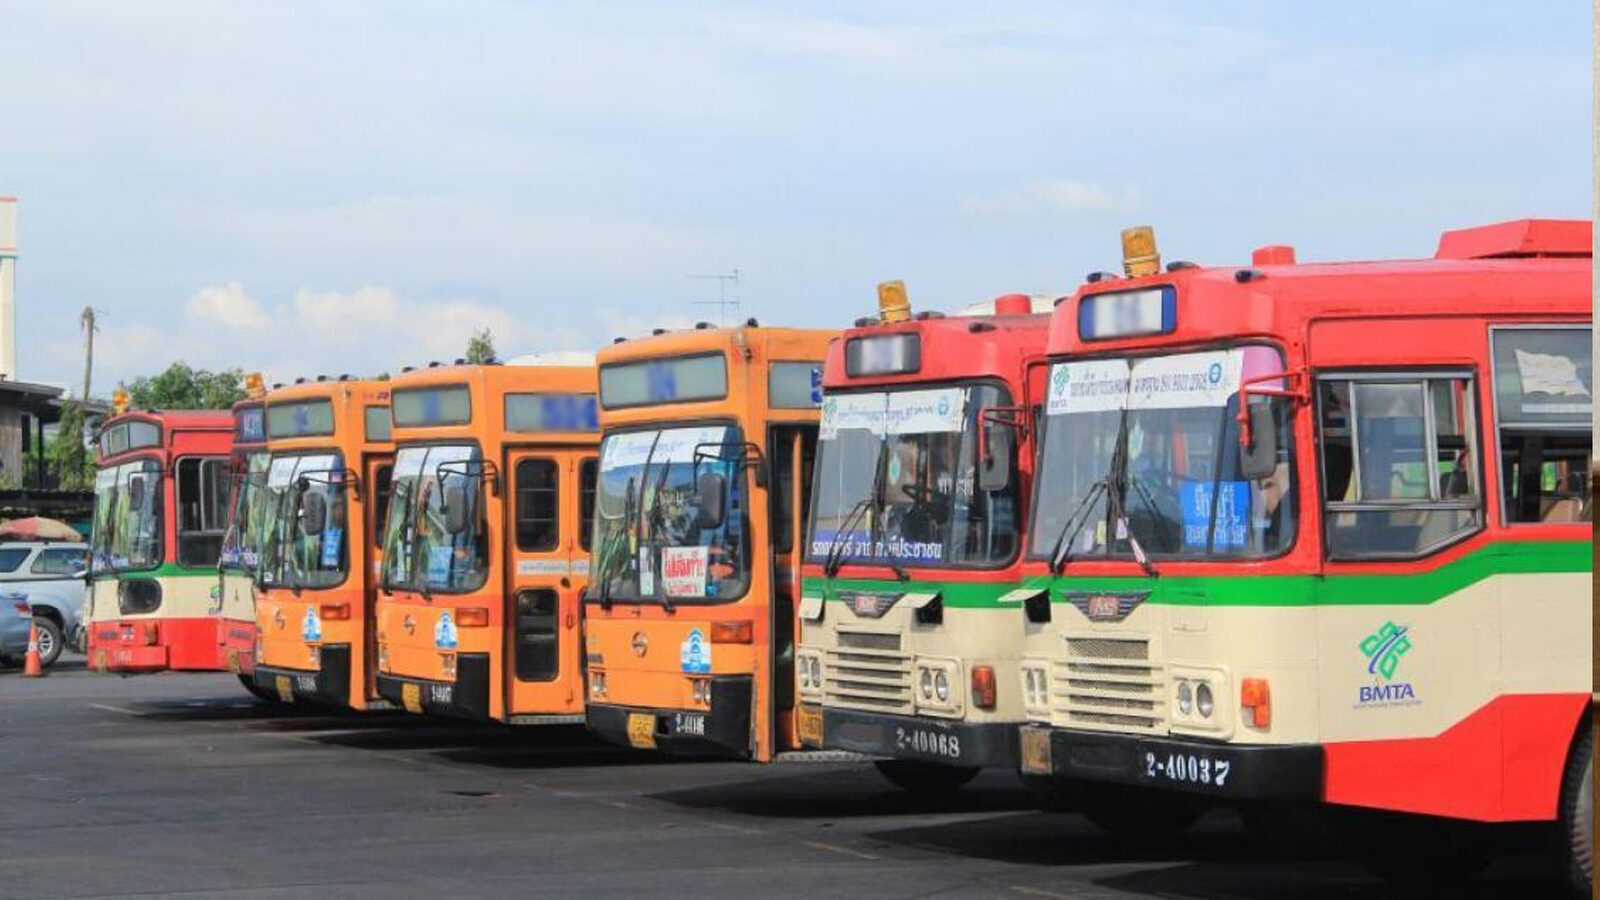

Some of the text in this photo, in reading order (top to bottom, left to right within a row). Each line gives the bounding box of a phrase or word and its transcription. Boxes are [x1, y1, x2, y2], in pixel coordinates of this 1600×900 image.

[1360, 684, 1415, 702] BMTA
[896, 727, 960, 758] 2-40068
[1146, 752, 1230, 786] 2-40037
